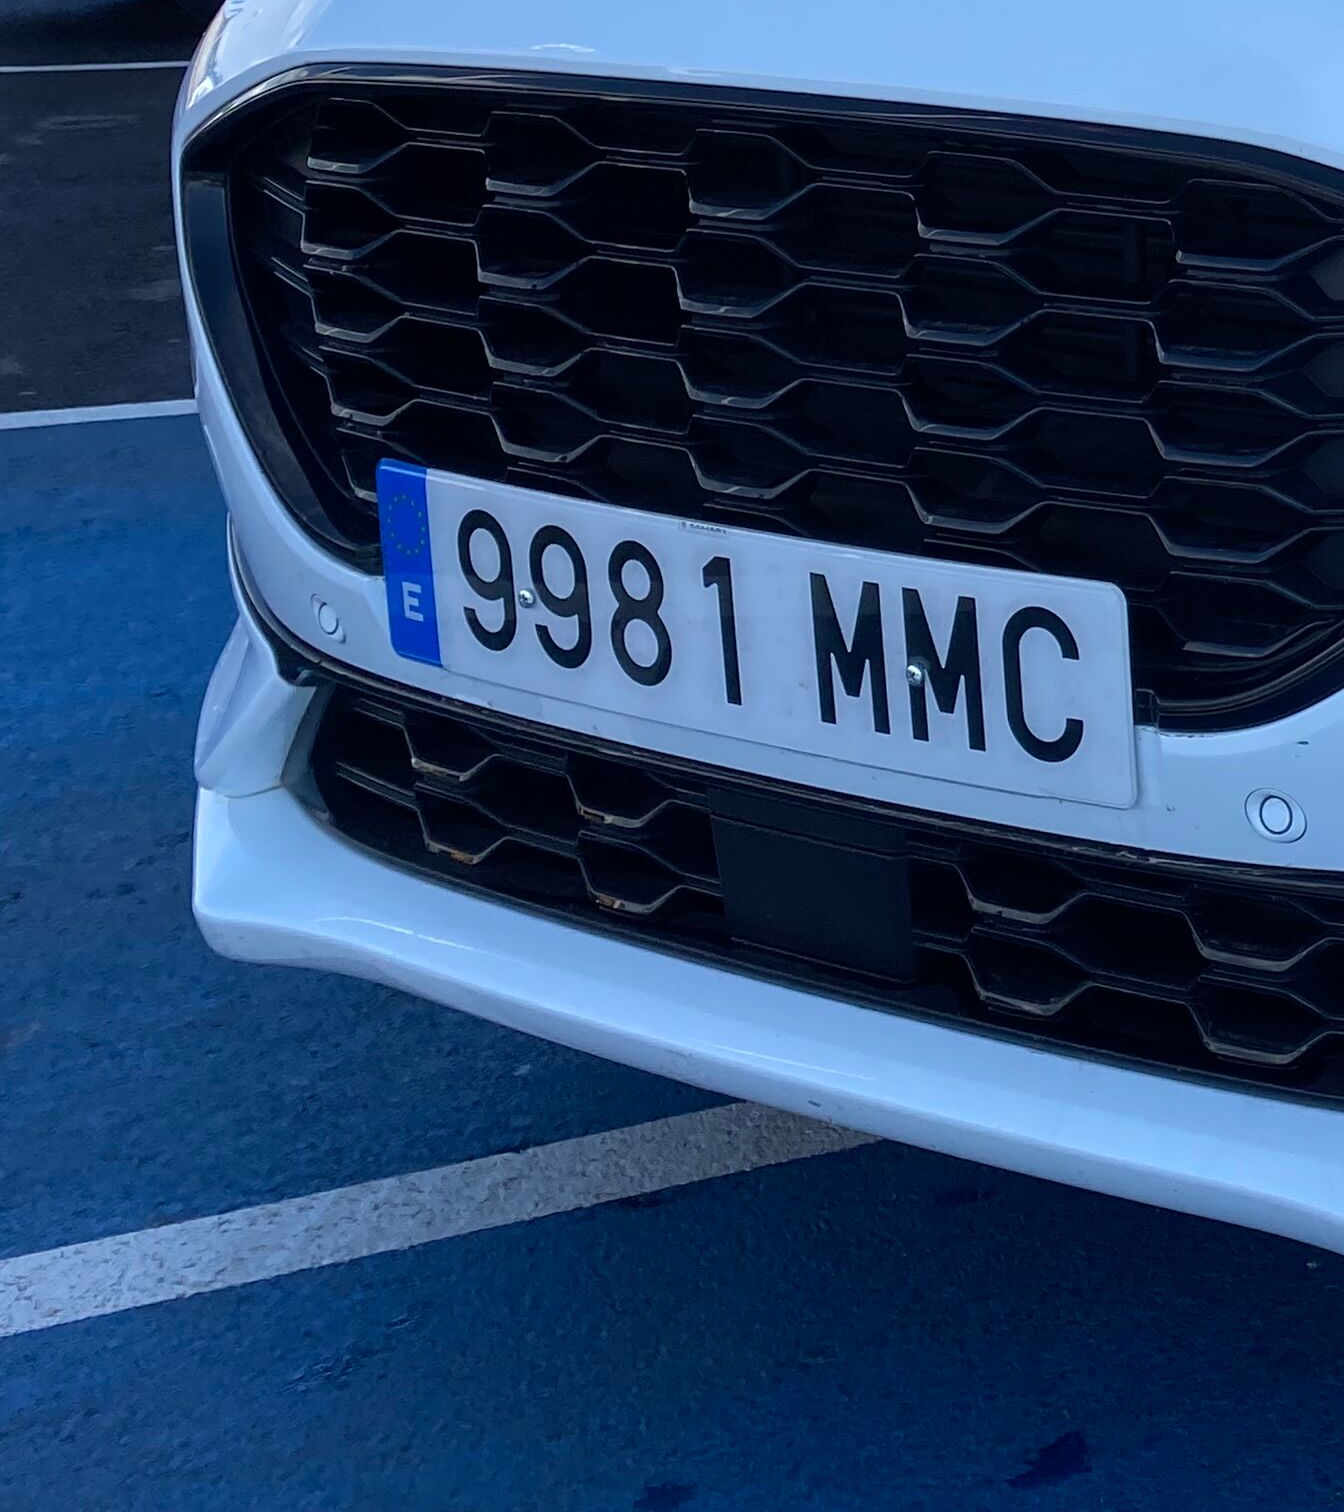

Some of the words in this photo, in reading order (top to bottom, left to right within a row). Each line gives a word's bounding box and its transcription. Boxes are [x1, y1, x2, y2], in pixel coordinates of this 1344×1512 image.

[401, 580, 424, 623] E
[456, 509, 743, 706] 9981
[809, 572, 1085, 763] MMC
